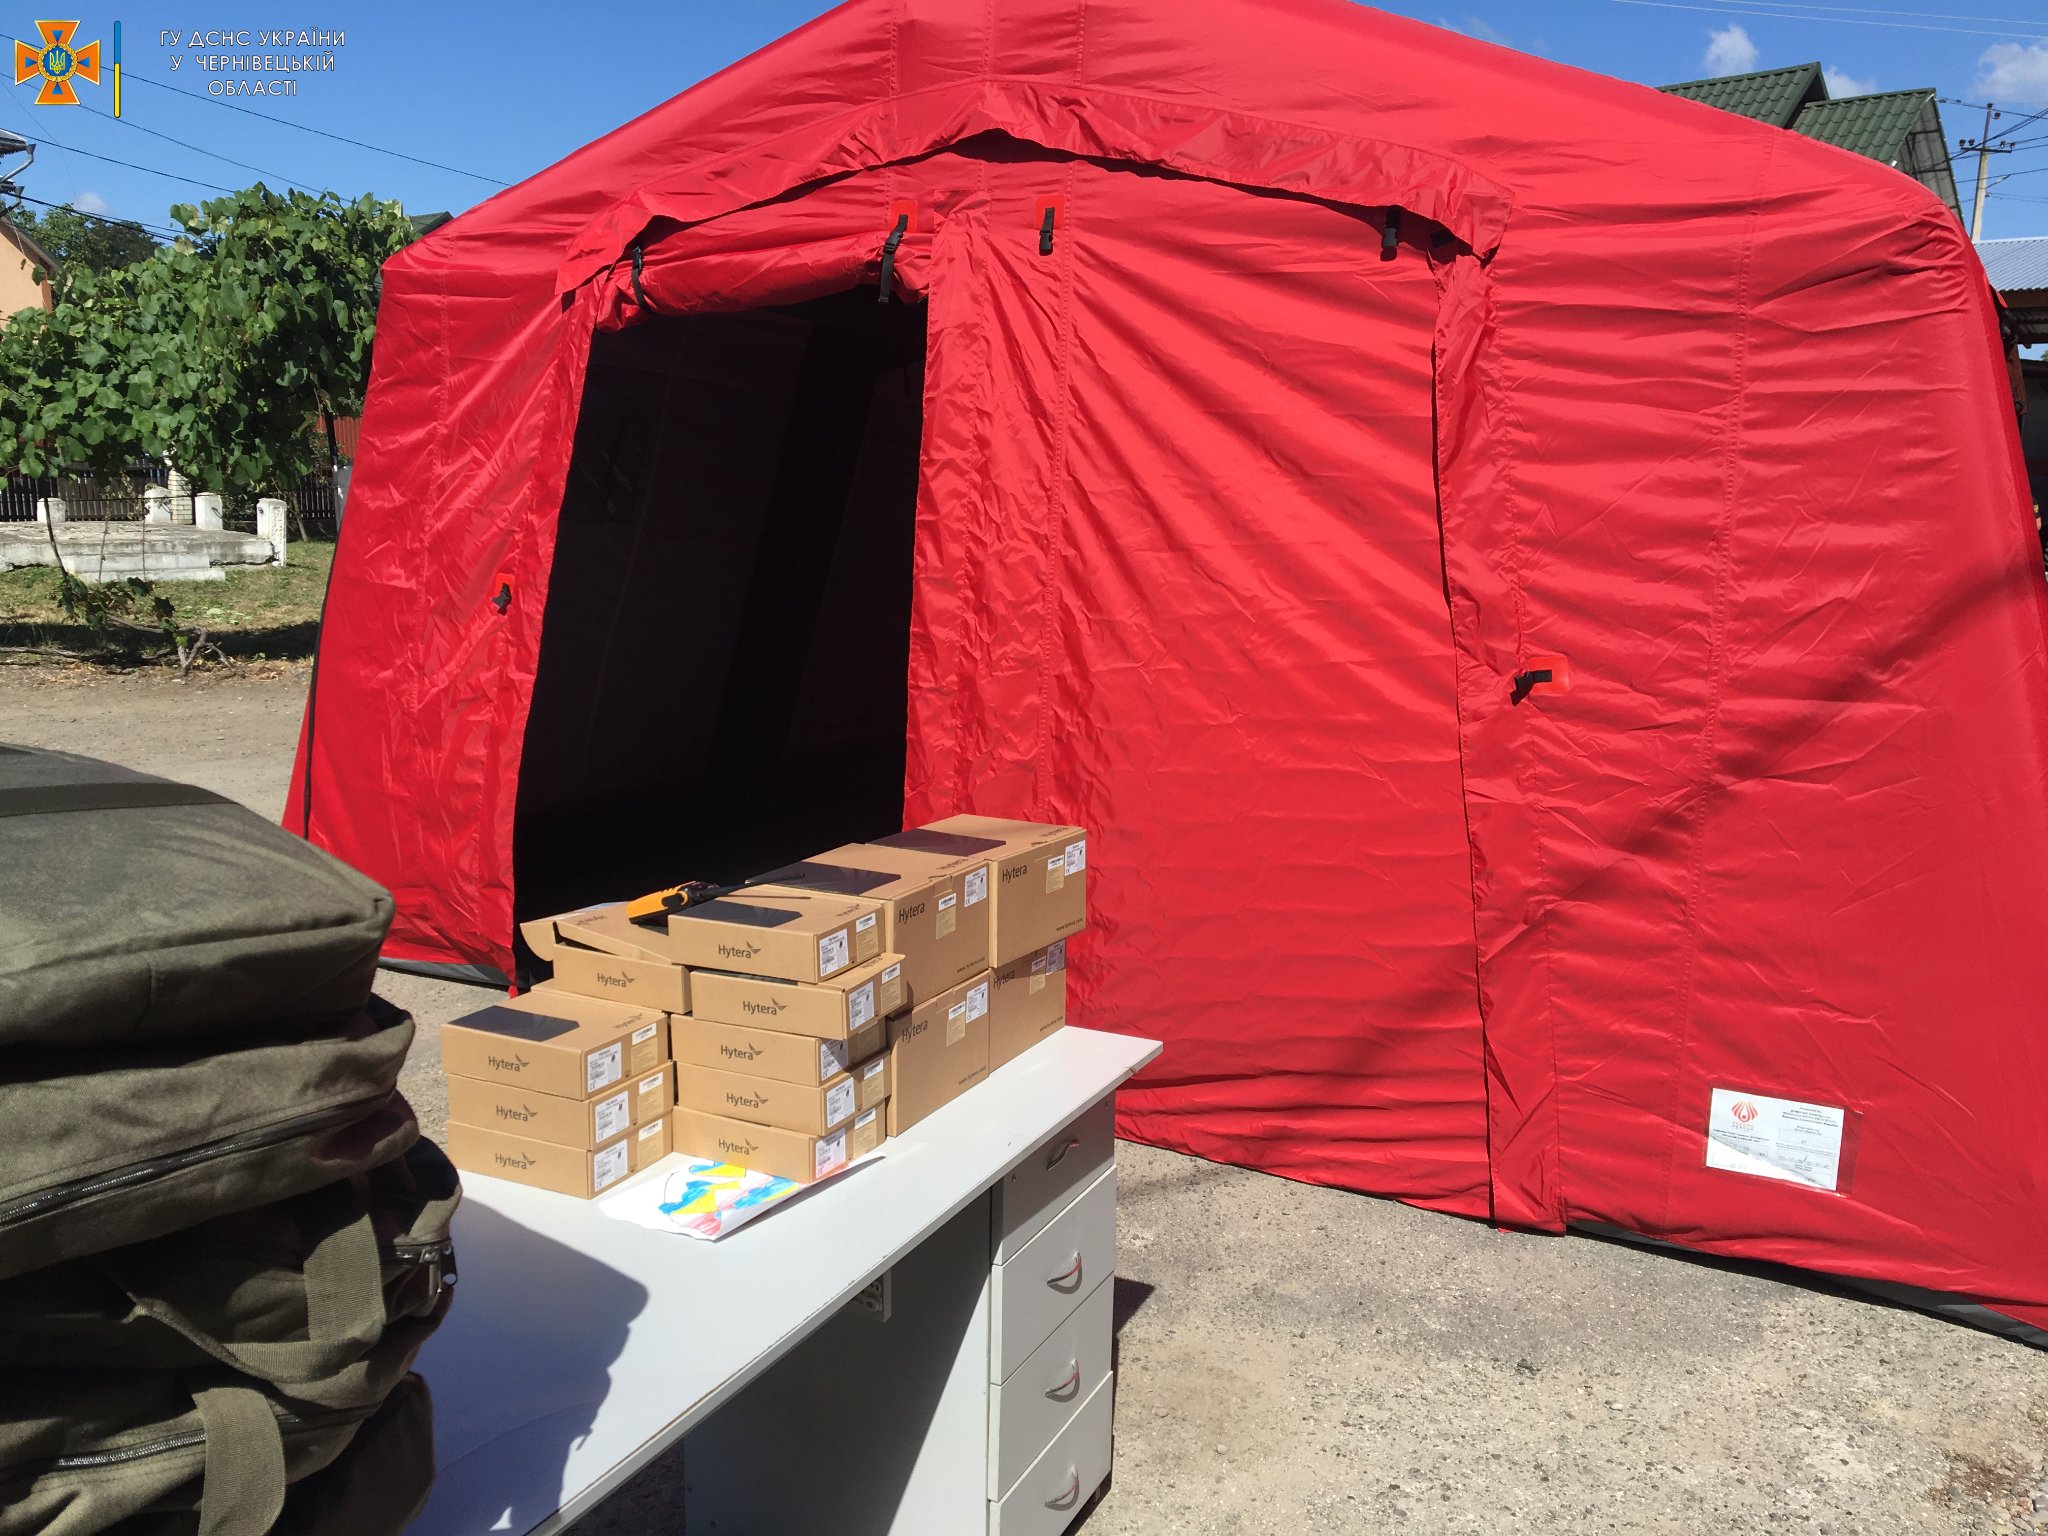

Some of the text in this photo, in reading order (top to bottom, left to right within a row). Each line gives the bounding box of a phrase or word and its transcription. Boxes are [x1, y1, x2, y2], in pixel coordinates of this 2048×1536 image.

[1002, 863, 1028, 884] Hytera
[898, 901, 925, 925] Hytera
[718, 943, 752, 959] Hytera
[597, 972, 627, 988] Hytera
[993, 969, 1015, 991] Hytera
[743, 1001, 777, 1017] Hytera
[901, 1019, 928, 1043] Hytera
[720, 1045, 754, 1061] Hytera
[488, 1055, 521, 1072] Hytera
[726, 1093, 759, 1109] Hytera
[496, 1104, 528, 1122] Hytera
[718, 1140, 750, 1155] Hytera
[495, 1153, 527, 1170] Hytera
